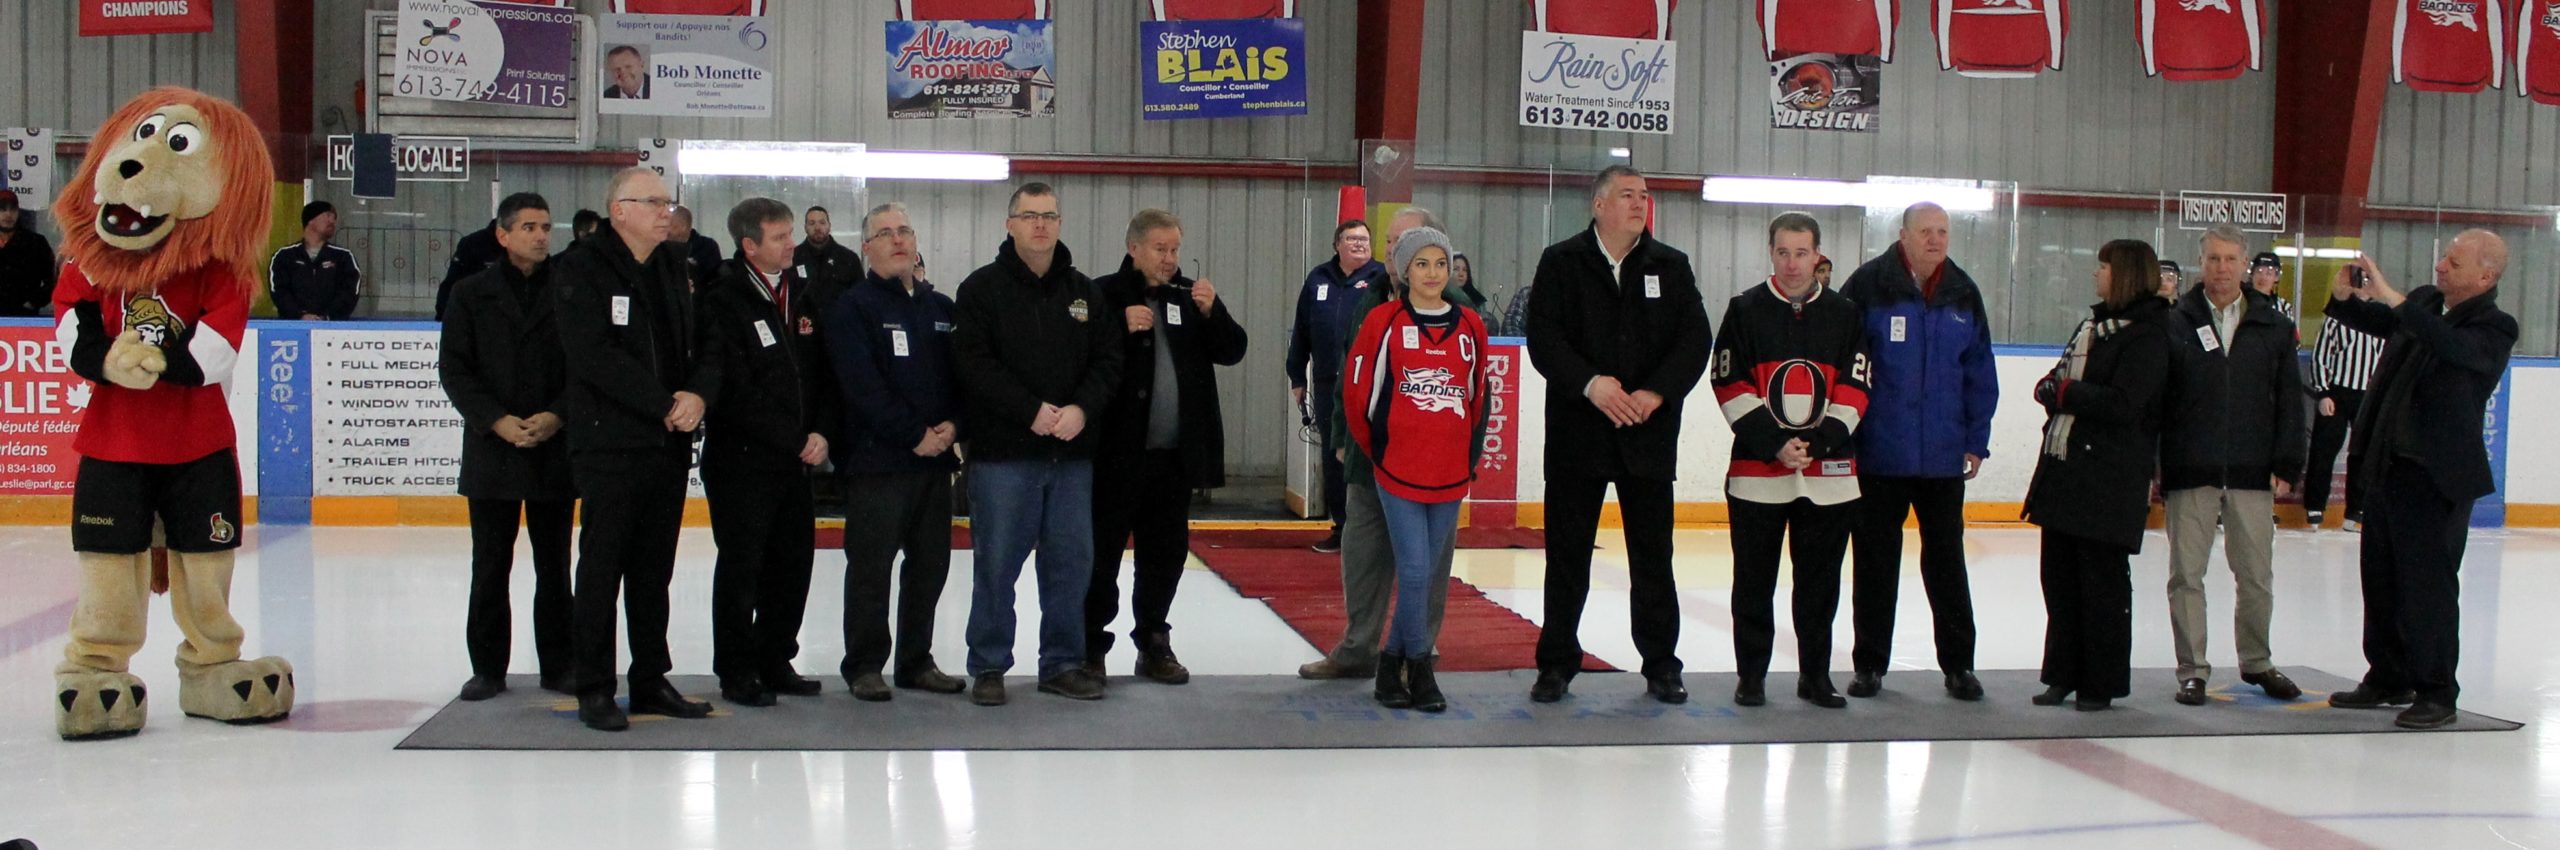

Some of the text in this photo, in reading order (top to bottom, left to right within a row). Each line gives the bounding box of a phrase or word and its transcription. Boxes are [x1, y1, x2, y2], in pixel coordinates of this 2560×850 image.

[102, 0, 188, 17] CHAMPIONS
[616, 20, 650, 31] Support
[653, 22, 669, 30] our
[676, 22, 713, 32] Appuyez
[895, 25, 1013, 72] Almar
[1157, 30, 1237, 55] Stephen
[407, 48, 468, 67] NOVA
[506, 67, 566, 82] Print Solutions
[657, 64, 762, 80] Bob Monette
[910, 62, 1005, 79] ROOFING
[399, 73, 566, 107] 613-749-4115
[923, 84, 1021, 95] 613-824-3578
[1179, 83, 1270, 92] Councillor Conseiller
[1144, 103, 1199, 112] 613.580.2489
[1242, 100, 1306, 110] stephenblais.ca
[1525, 91, 1670, 111] Water Treatment Since 1953
[893, 110, 935, 119] Complete
[1780, 109, 1869, 130] DESIGN
[396, 145, 463, 172] LOCALE
[342, 341, 438, 350] AUTO DETAI
[1458, 333, 1471, 362] C
[341, 361, 440, 370] FULL MECHA
[1353, 354, 1364, 385] 1
[0, 381, 61, 415] LIE
[1400, 382, 1466, 399] BANDITS
[342, 400, 453, 409] WINDOW TINT
[0, 420, 39, 435] éputé
[0, 441, 48, 456] rléans
[342, 438, 410, 447] ALARMS
[7, 463, 56, 473] 834-1800
[342, 457, 462, 466] TRAILER HITCH
[342, 477, 459, 486] TRUCK ACCES
[80, 514, 114, 526] Reebok
